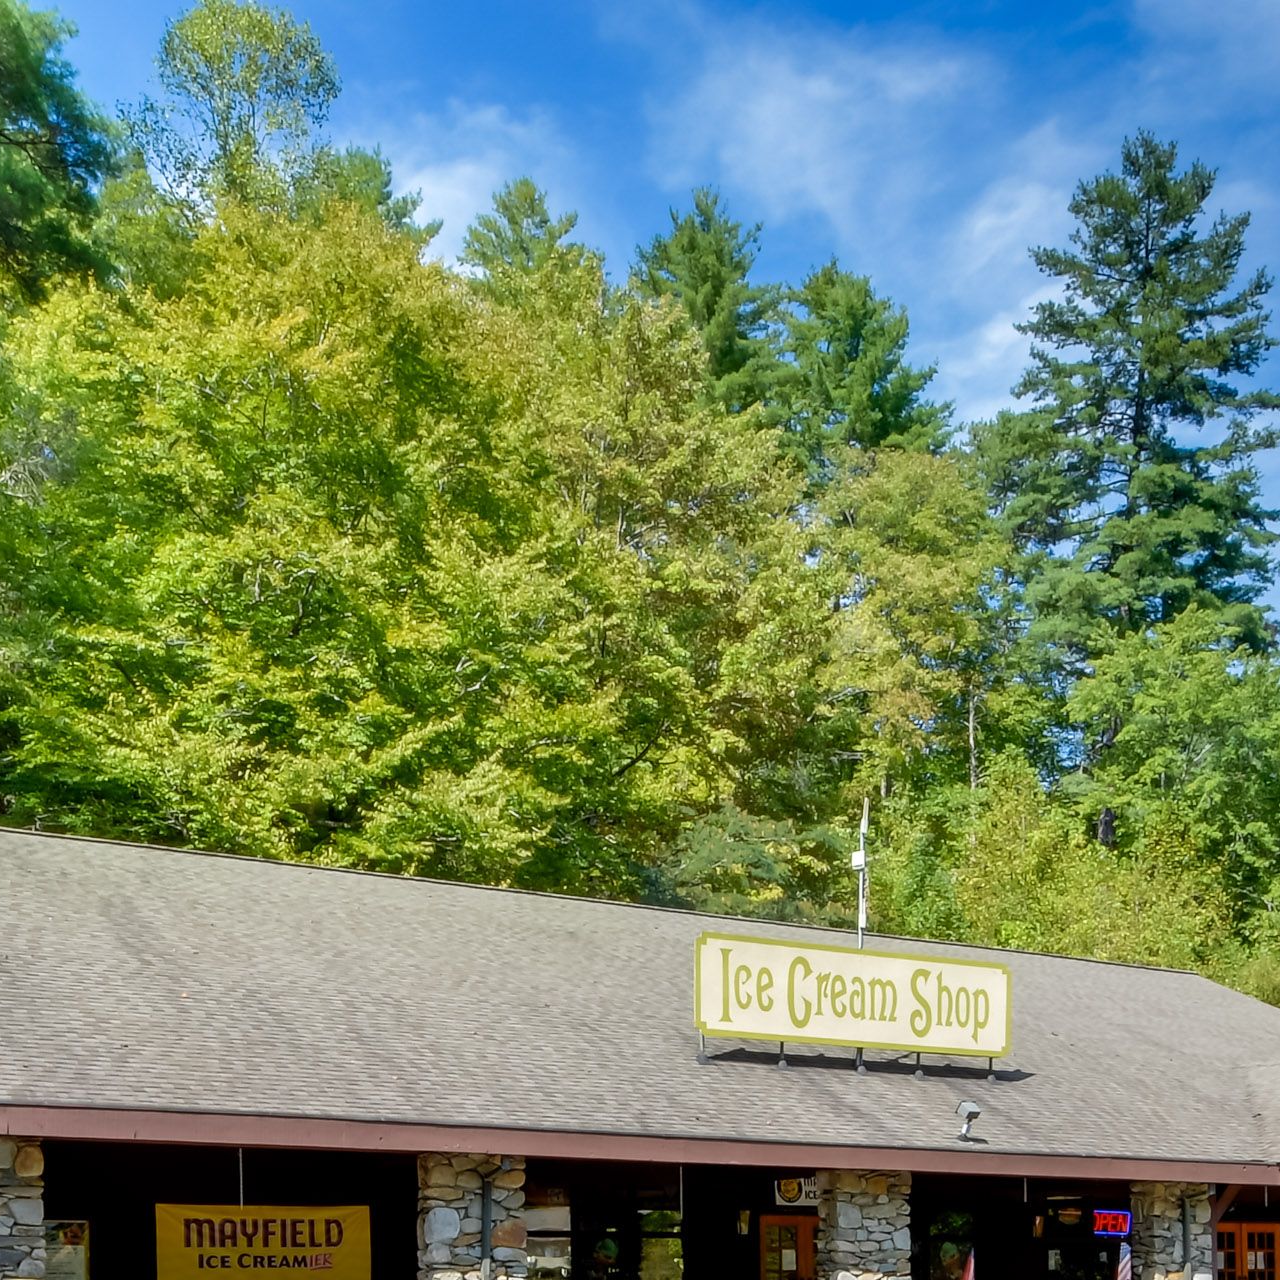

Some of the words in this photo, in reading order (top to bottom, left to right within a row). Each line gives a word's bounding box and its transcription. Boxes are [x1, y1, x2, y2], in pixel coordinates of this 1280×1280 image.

[718, 947, 774, 1023] Ice
[787, 955, 898, 1029] Cream
[909, 967, 990, 1044] Shop
[183, 1217, 344, 1248] MAYFIELD
[197, 1253, 232, 1269] ICE
